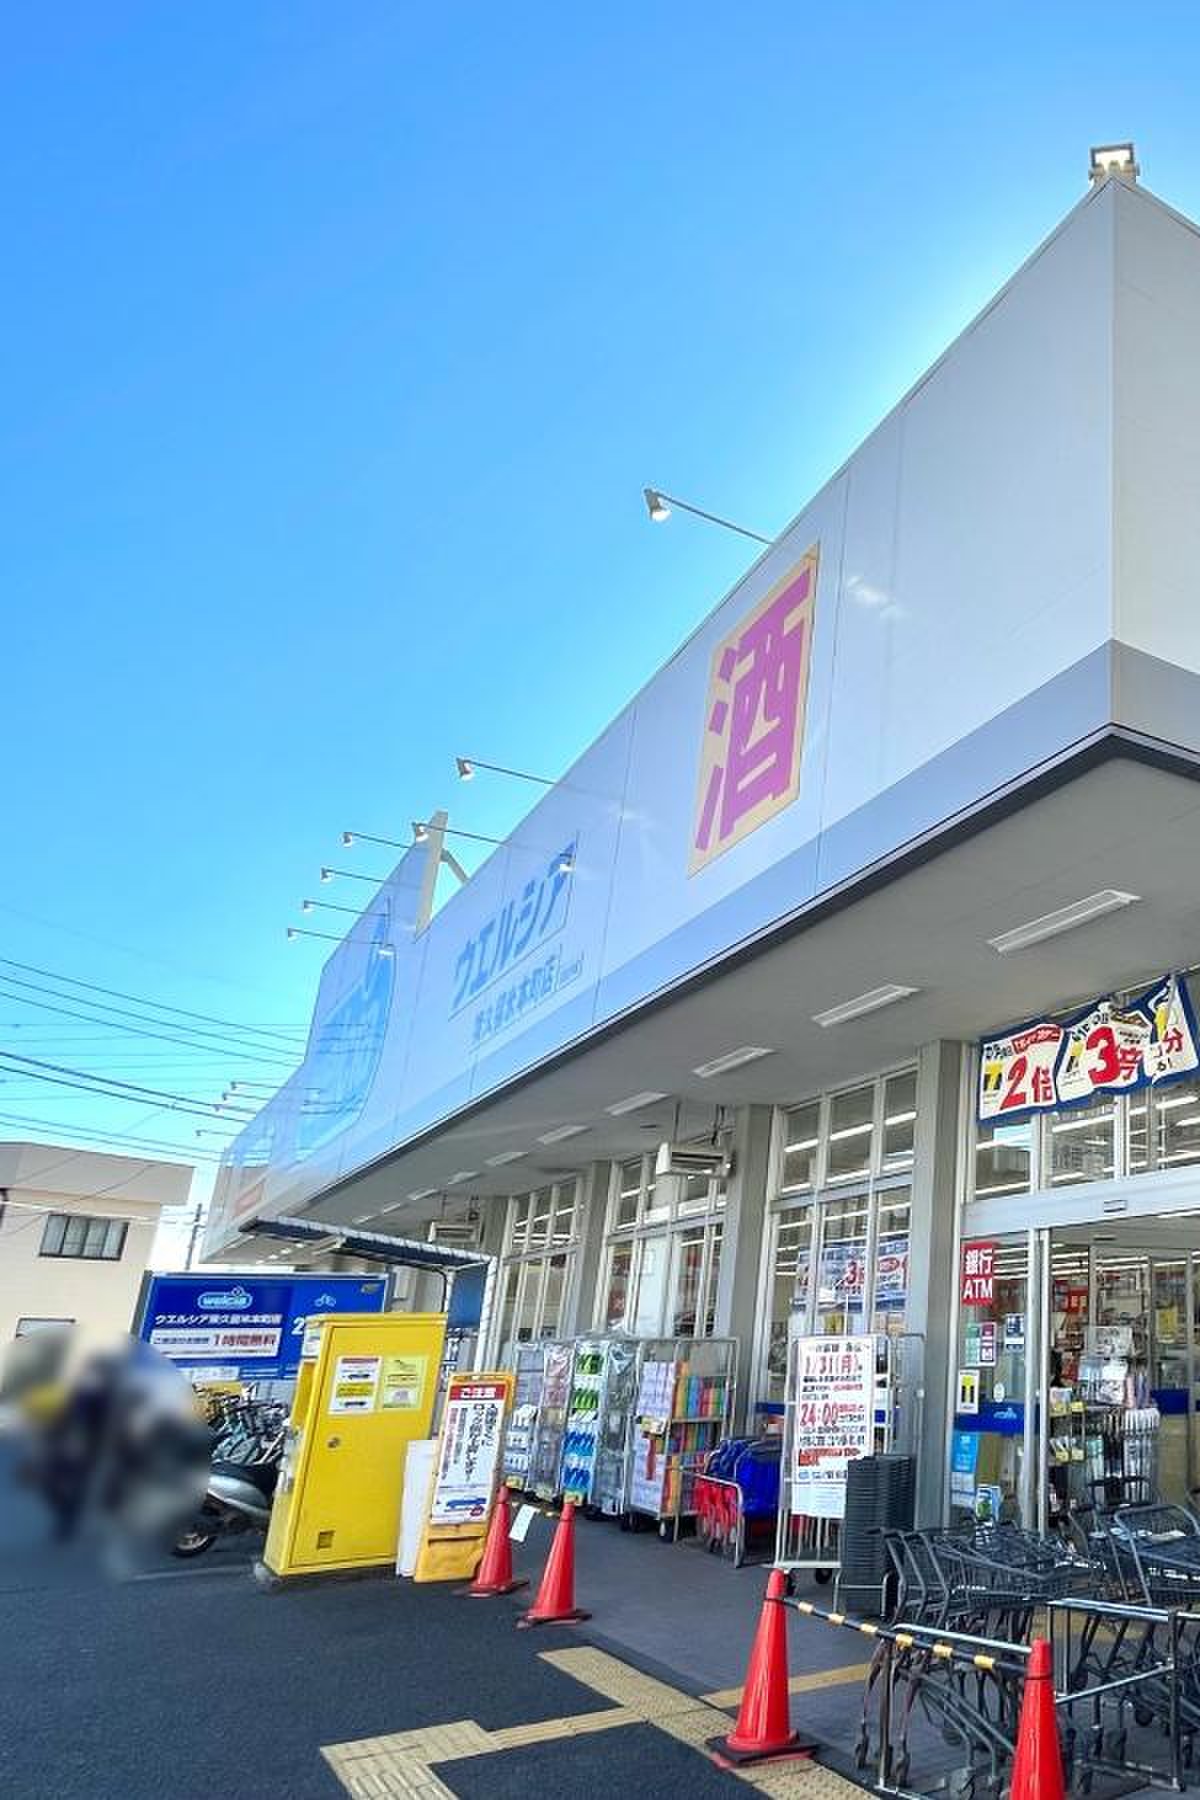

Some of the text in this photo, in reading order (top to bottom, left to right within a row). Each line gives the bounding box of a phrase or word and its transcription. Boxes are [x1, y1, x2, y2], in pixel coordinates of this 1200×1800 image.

[695, 569, 811, 850] 酒
[452, 840, 576, 1009] ウエルシア
[963, 1279, 992, 1299] ATM
[965, 1249, 992, 1275] 銀行
